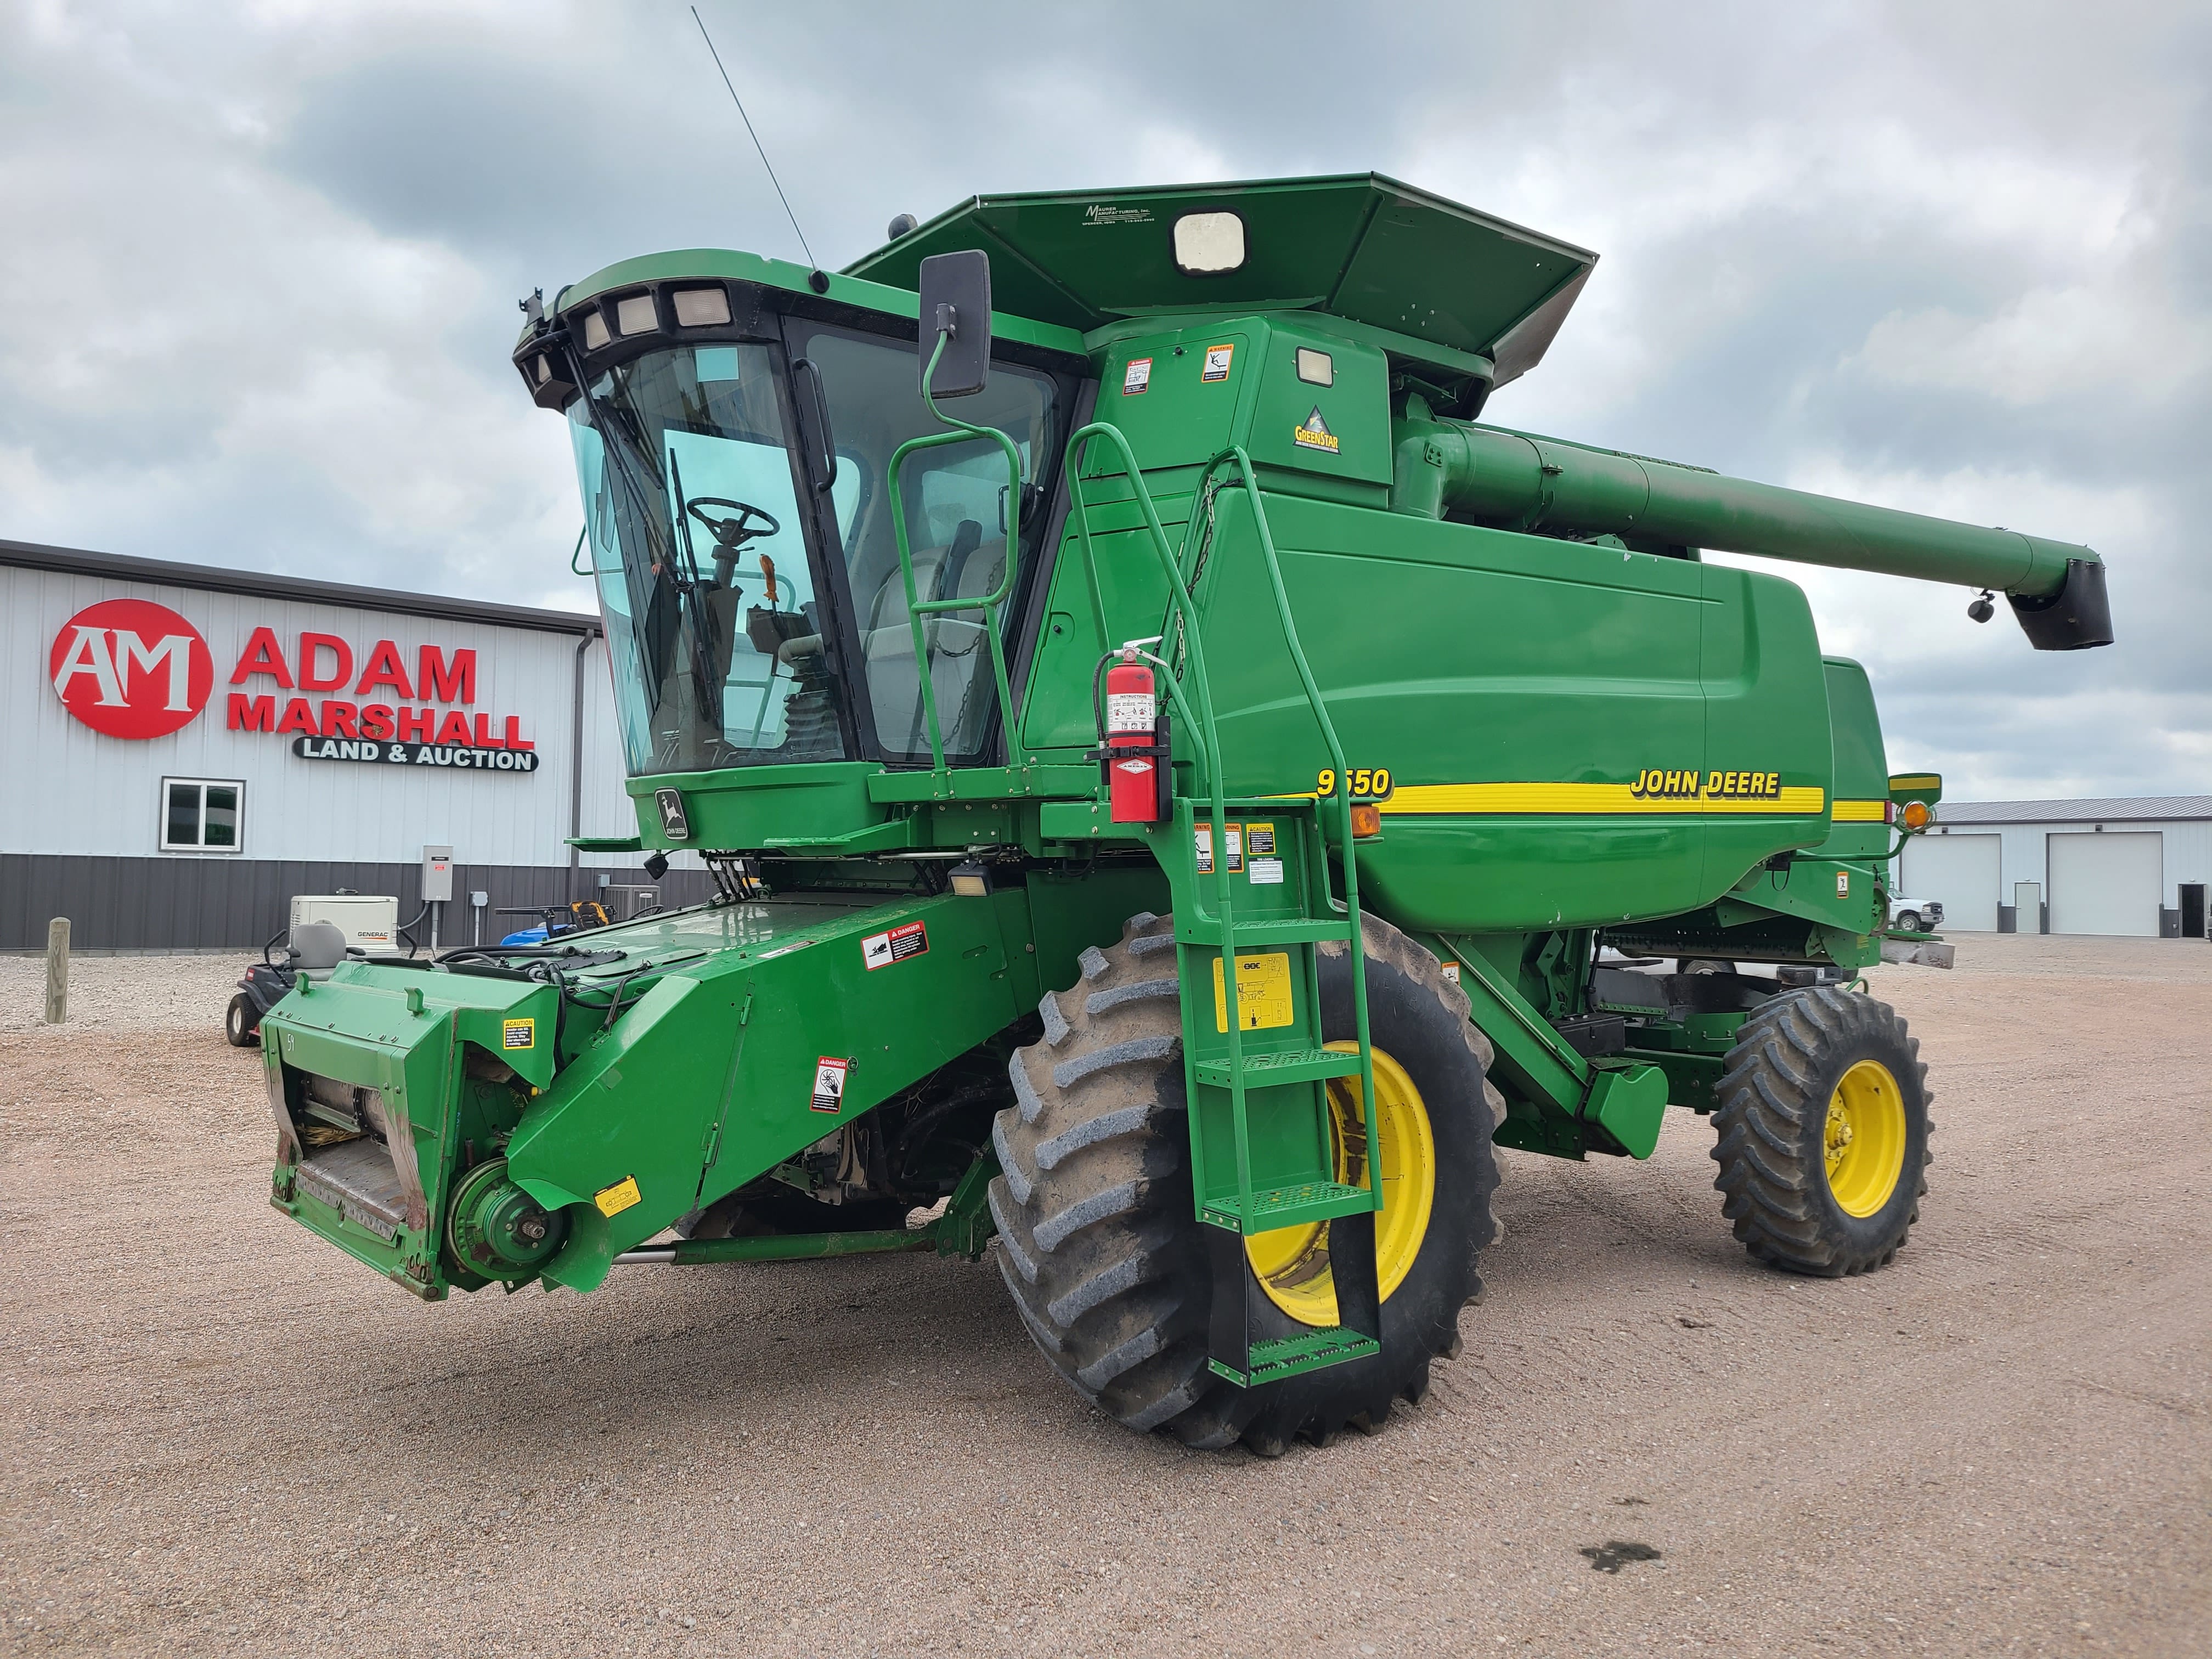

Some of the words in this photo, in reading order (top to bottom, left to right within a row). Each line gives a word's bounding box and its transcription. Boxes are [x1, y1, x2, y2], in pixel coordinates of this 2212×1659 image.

[54, 625, 195, 712] AM
[229, 627, 477, 704] ADAM
[227, 692, 535, 750] MARSHALL
[303, 738, 379, 761] LAND
[388, 744, 408, 763] &
[416, 747, 533, 770] AUCTION
[1630, 770, 1699, 793] JOHN
[1707, 771, 1779, 794] DEERE
[897, 924, 920, 936] DANGER
[287, 1034, 294, 1052] 59
[825, 1059, 846, 1067] DANGER
